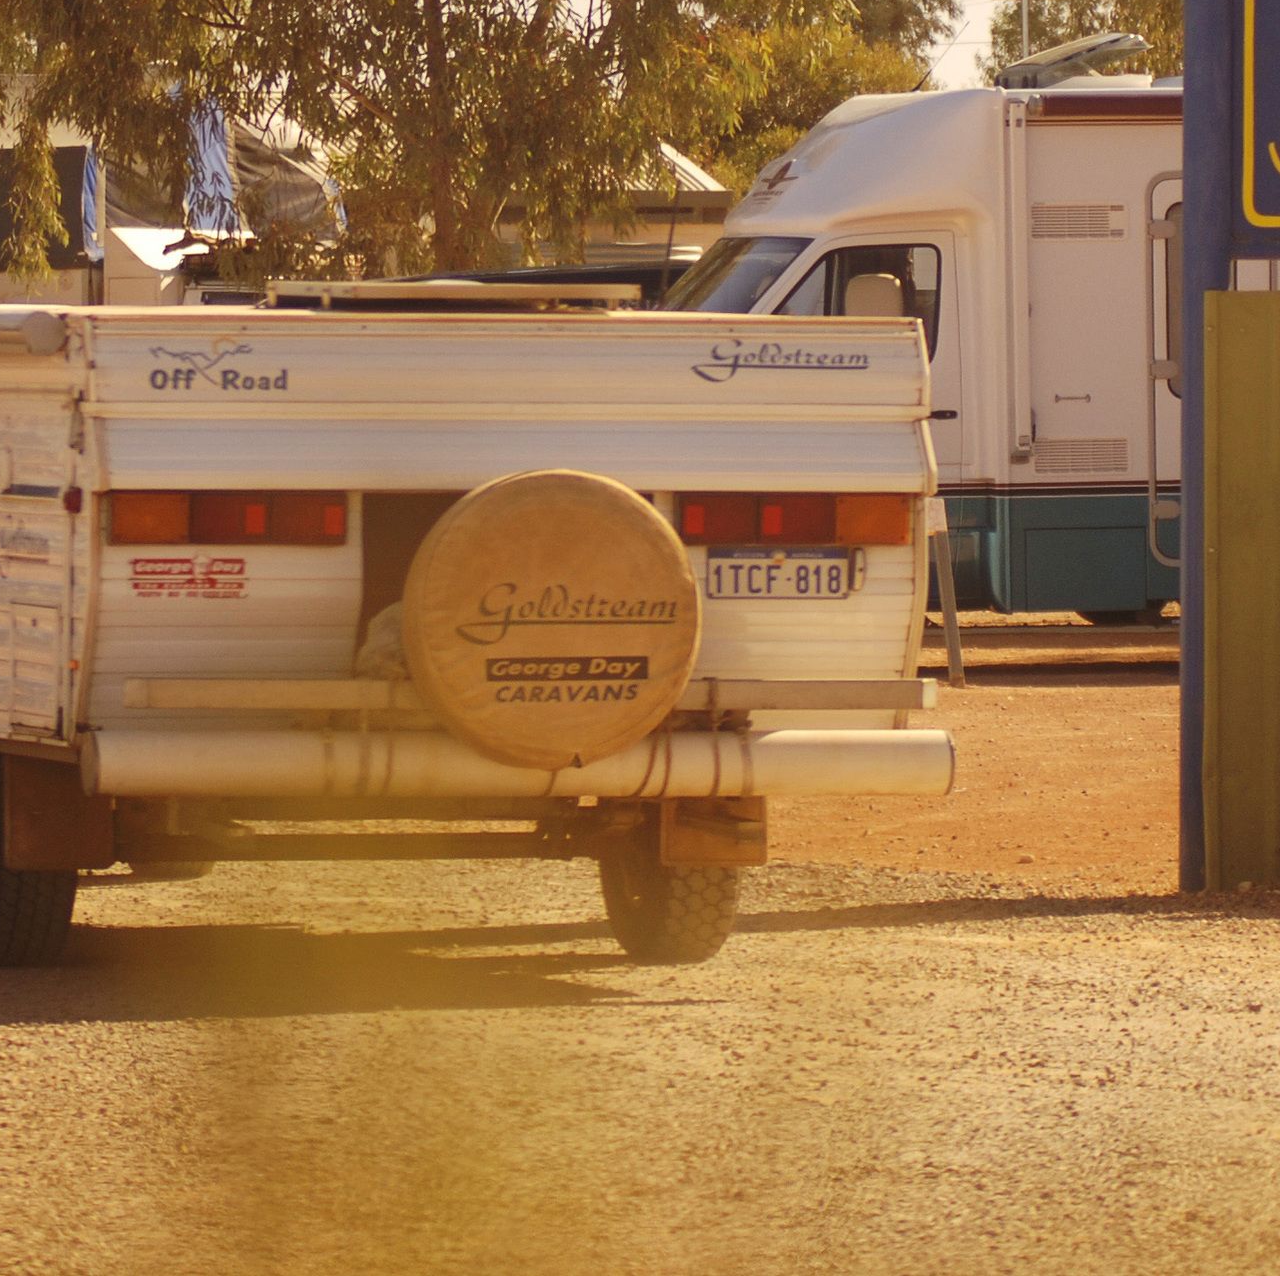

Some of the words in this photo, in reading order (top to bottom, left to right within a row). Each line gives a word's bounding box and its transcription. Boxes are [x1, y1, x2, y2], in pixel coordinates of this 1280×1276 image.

[691, 339, 870, 383] Goldstream
[149, 368, 196, 390] Off
[221, 369, 288, 390] Road
[456, 583, 677, 645] Goldstream
[491, 660, 581, 679] George
[588, 658, 640, 678] Day
[495, 684, 639, 703] CARAVANS
